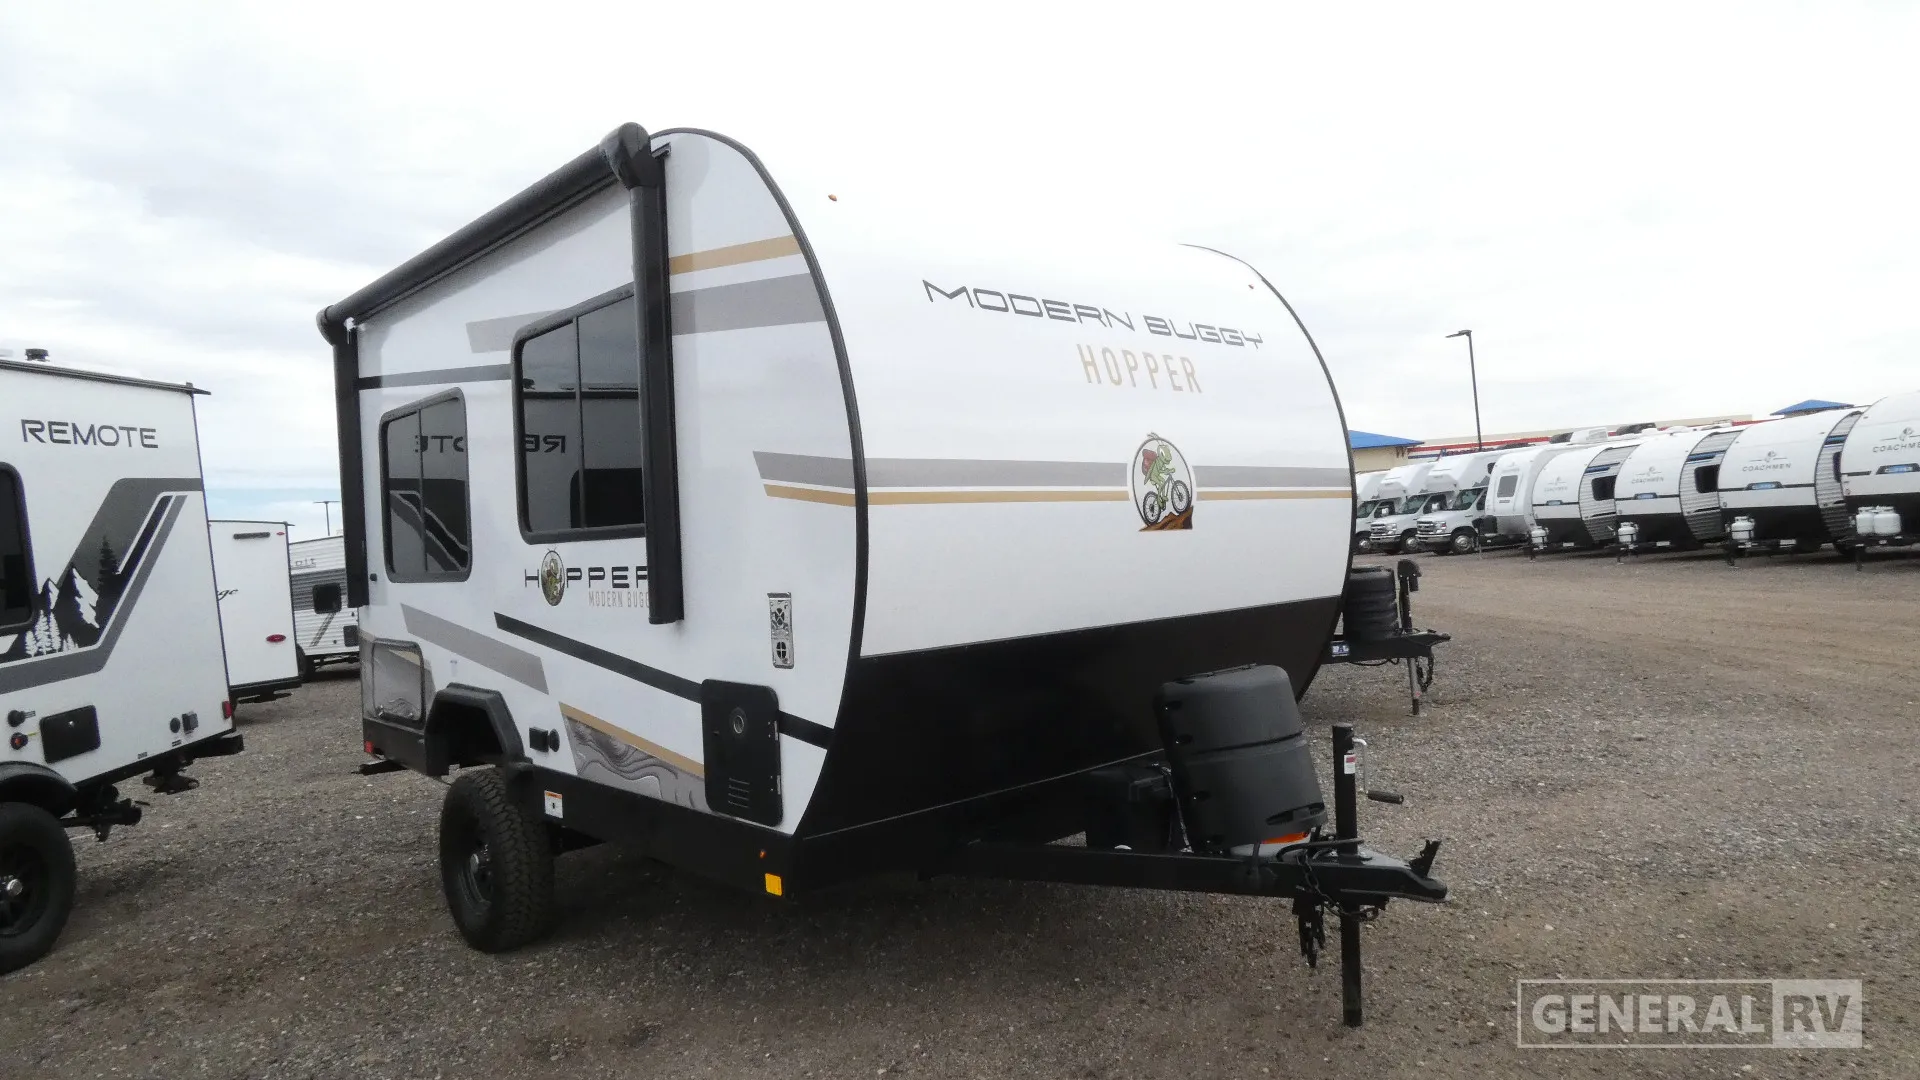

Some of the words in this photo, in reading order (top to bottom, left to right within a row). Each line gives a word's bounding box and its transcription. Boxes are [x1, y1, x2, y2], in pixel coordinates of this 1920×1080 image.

[922, 279, 1135, 331] MODERN
[1143, 314, 1264, 350] BUGGY
[1076, 343, 1203, 394] HOPPER
[20, 418, 159, 449] REMOTE
[1872, 441, 1920, 453] COACHME
[1742, 463, 1791, 472] COACHMEN
[588, 590, 623, 607] MODERN
